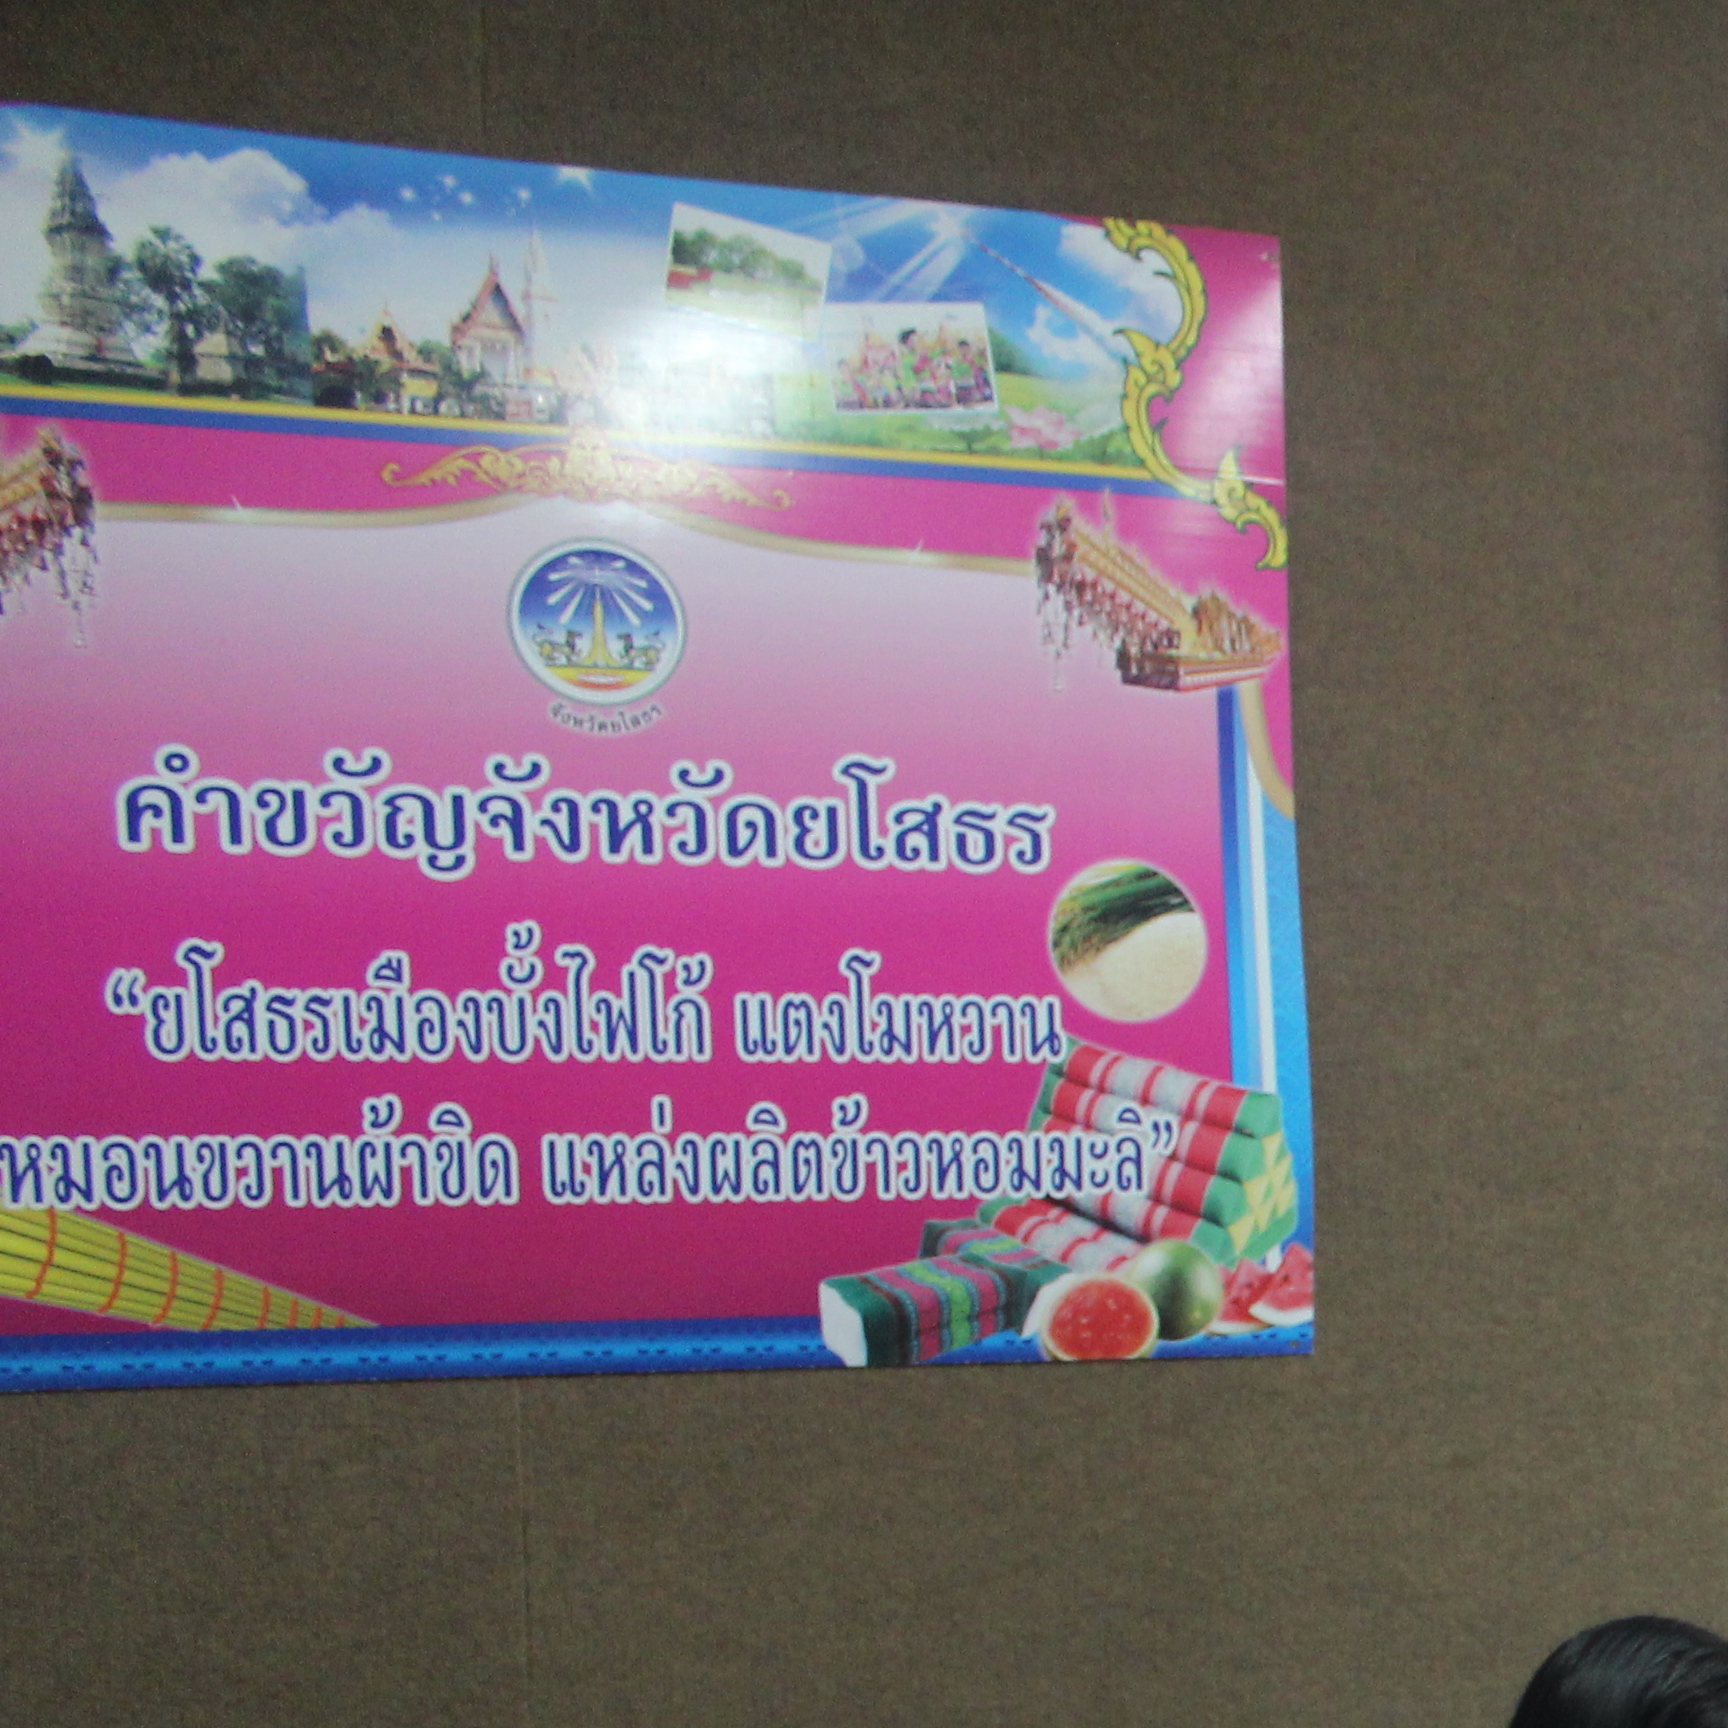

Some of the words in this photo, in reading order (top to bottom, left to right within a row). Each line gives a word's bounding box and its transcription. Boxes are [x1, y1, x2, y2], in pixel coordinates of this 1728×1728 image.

[124, 750, 1051, 873] คำขวัญจังหวัดยโสธร
[110, 926, 707, 1057] “ยโสธรเมืองบั้งไฟโก้
[738, 953, 1062, 1058] แตงโมหวาน
[0, 1099, 516, 1203] หมอนขวานผ้าขิด
[547, 1099, 1175, 1199] แหล่งผลิตข้าวหอมมะลิ”
